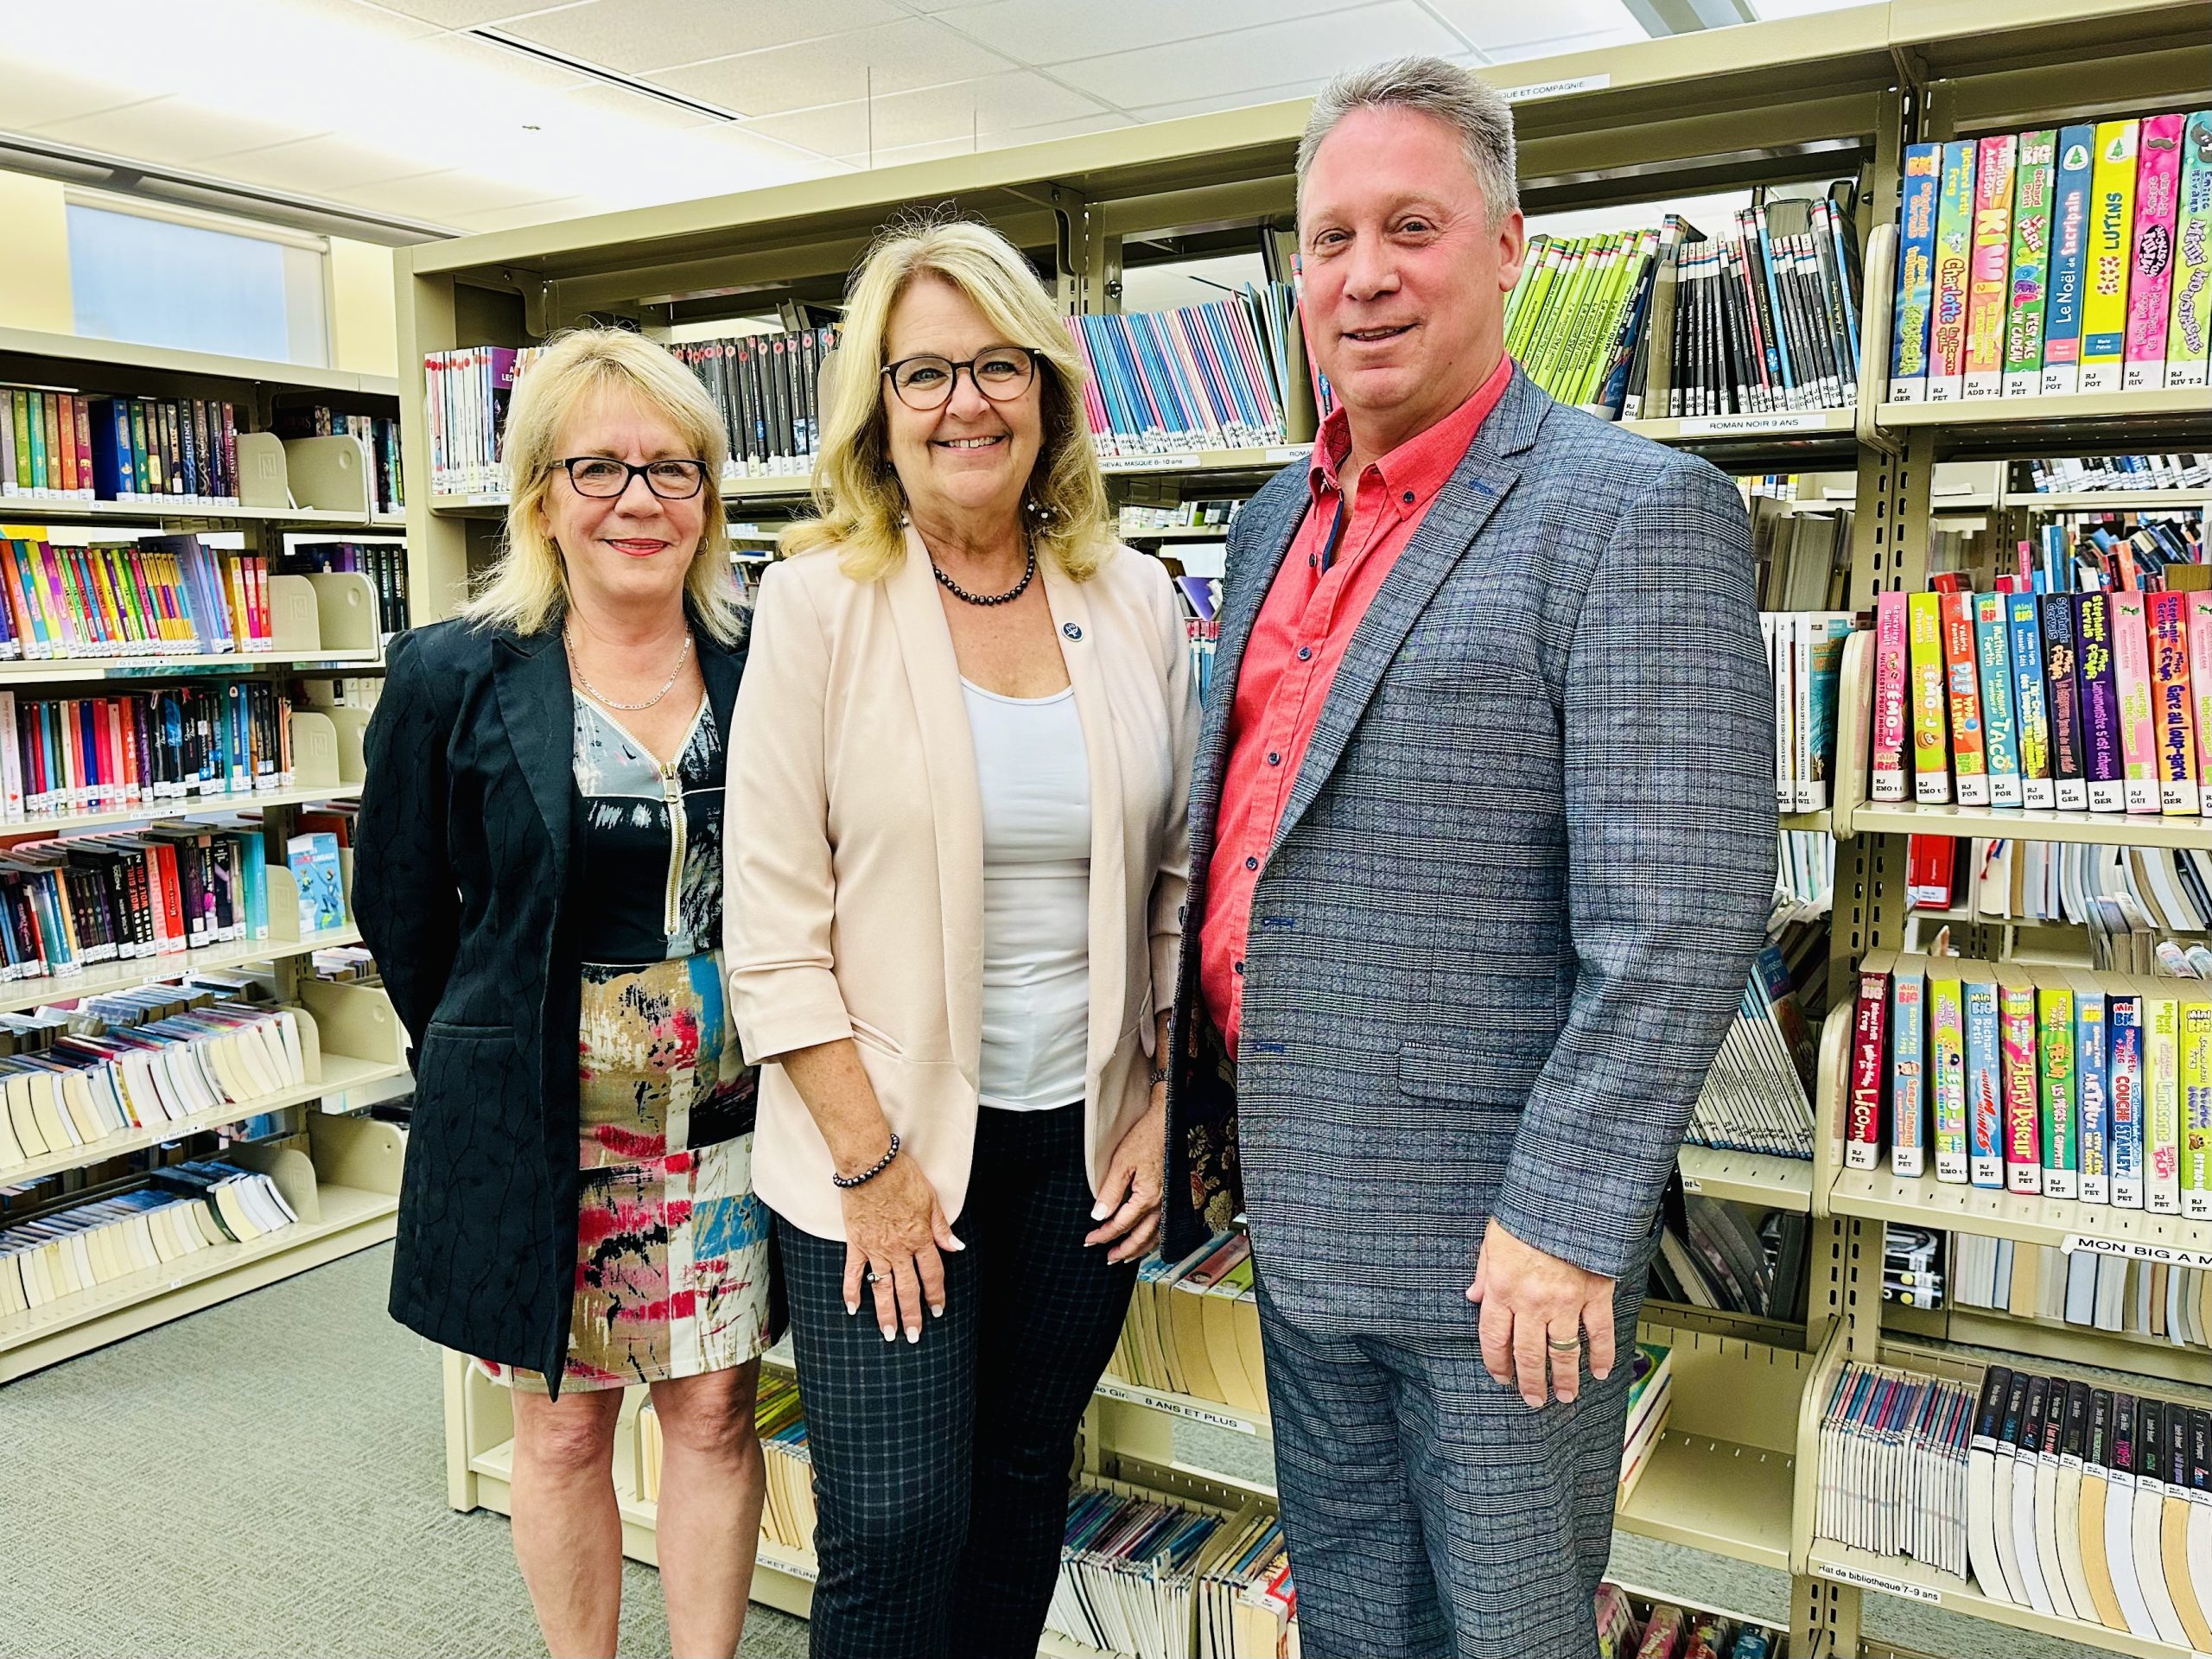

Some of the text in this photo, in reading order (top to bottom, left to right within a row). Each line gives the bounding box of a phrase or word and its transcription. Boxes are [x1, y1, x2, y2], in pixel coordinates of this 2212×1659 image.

[1533, 81, 1585, 94] COMPAGNIE
[1983, 149, 1996, 198] Addison
[1995, 147, 2008, 194] Marilou
[2032, 168, 2044, 207] Richard
[2022, 183, 2033, 208] Petit
[1908, 194, 1921, 239] Gervais
[2017, 218, 2044, 252] PÈRE
[2060, 191, 2082, 256] Sacripain
[2103, 192, 2123, 250] LUTINS
[1974, 208, 2009, 295] KIWI
[2068, 257, 2075, 267] de
[1940, 258, 1966, 325] Charlotte
[2012, 247, 2046, 308] NOËL
[2056, 270, 2076, 302] Noël
[2055, 305, 2072, 324] Le
[1567, 340, 1575, 353] PAS
[1573, 315, 1582, 338] possible
[1576, 339, 1585, 351] PAS
[1578, 350, 1588, 371] Mission
[1586, 336, 1595, 349] PAS
[1592, 311, 1603, 335] possible
[2009, 311, 2023, 363] UN CADEAU
[183, 420, 192, 459] SENTENCE
[1915, 607, 1924, 644] Thomas
[1926, 614, 1935, 644] Daniel
[2047, 602, 2058, 640] Gervais
[2056, 596, 2070, 643] Stéphanie
[2082, 601, 2093, 639] Gervais
[2092, 594, 2107, 642] Stéphanie
[2157, 602, 2169, 639] Gervais
[1983, 636, 1995, 667] Fortin
[1993, 626, 2005, 666] Mathieu
[1949, 660, 1974, 695] PIF
[1923, 672, 1937, 728] ÉMO-J
[2167, 684, 2186, 709] Gare
[1884, 690, 1903, 747] ÉMO-J
[2168, 712, 2183, 725] au
[1988, 719, 2013, 770] TACO
[127, 866, 136, 886] GIRL
[137, 865, 145, 883] GIRL
[130, 887, 140, 912] WOLF
[139, 886, 149, 908] WOLF
[143, 909, 149, 921] DO
[134, 912, 141, 925] DO
[1937, 994, 1947, 1027] Thomas
[1947, 1001, 1956, 1027] Daniel
[2057, 997, 2067, 1032] Richard
[2156, 1014, 2164, 1034] Petit
[2164, 1002, 2173, 1033] Richard
[1972, 1018, 1983, 1045] Petit
[1983, 1018, 1994, 1061] Richard
[1946, 1071, 1961, 1128] ÉMO-J
[2009, 1061, 2034, 1160] Harry Péteur
[2082, 1072, 2103, 1129] ARTHUR
[2156, 1081, 2174, 1141] Lamacorne
[2115, 1076, 2132, 1172] COUCHE STANLEY
[2078, 1238, 2126, 1253] MON
[2134, 1247, 2171, 1259] BIG
[1156, 1400, 1180, 1412] ANS
[1185, 1408, 1199, 1417] ET
[1204, 1413, 1237, 1427] PLUS
[758, 1557, 785, 1570] CKET
[1836, 1568, 1847, 1577] de
[1903, 1585, 1919, 1596] 7-9
[1922, 1590, 1938, 1600] ans
